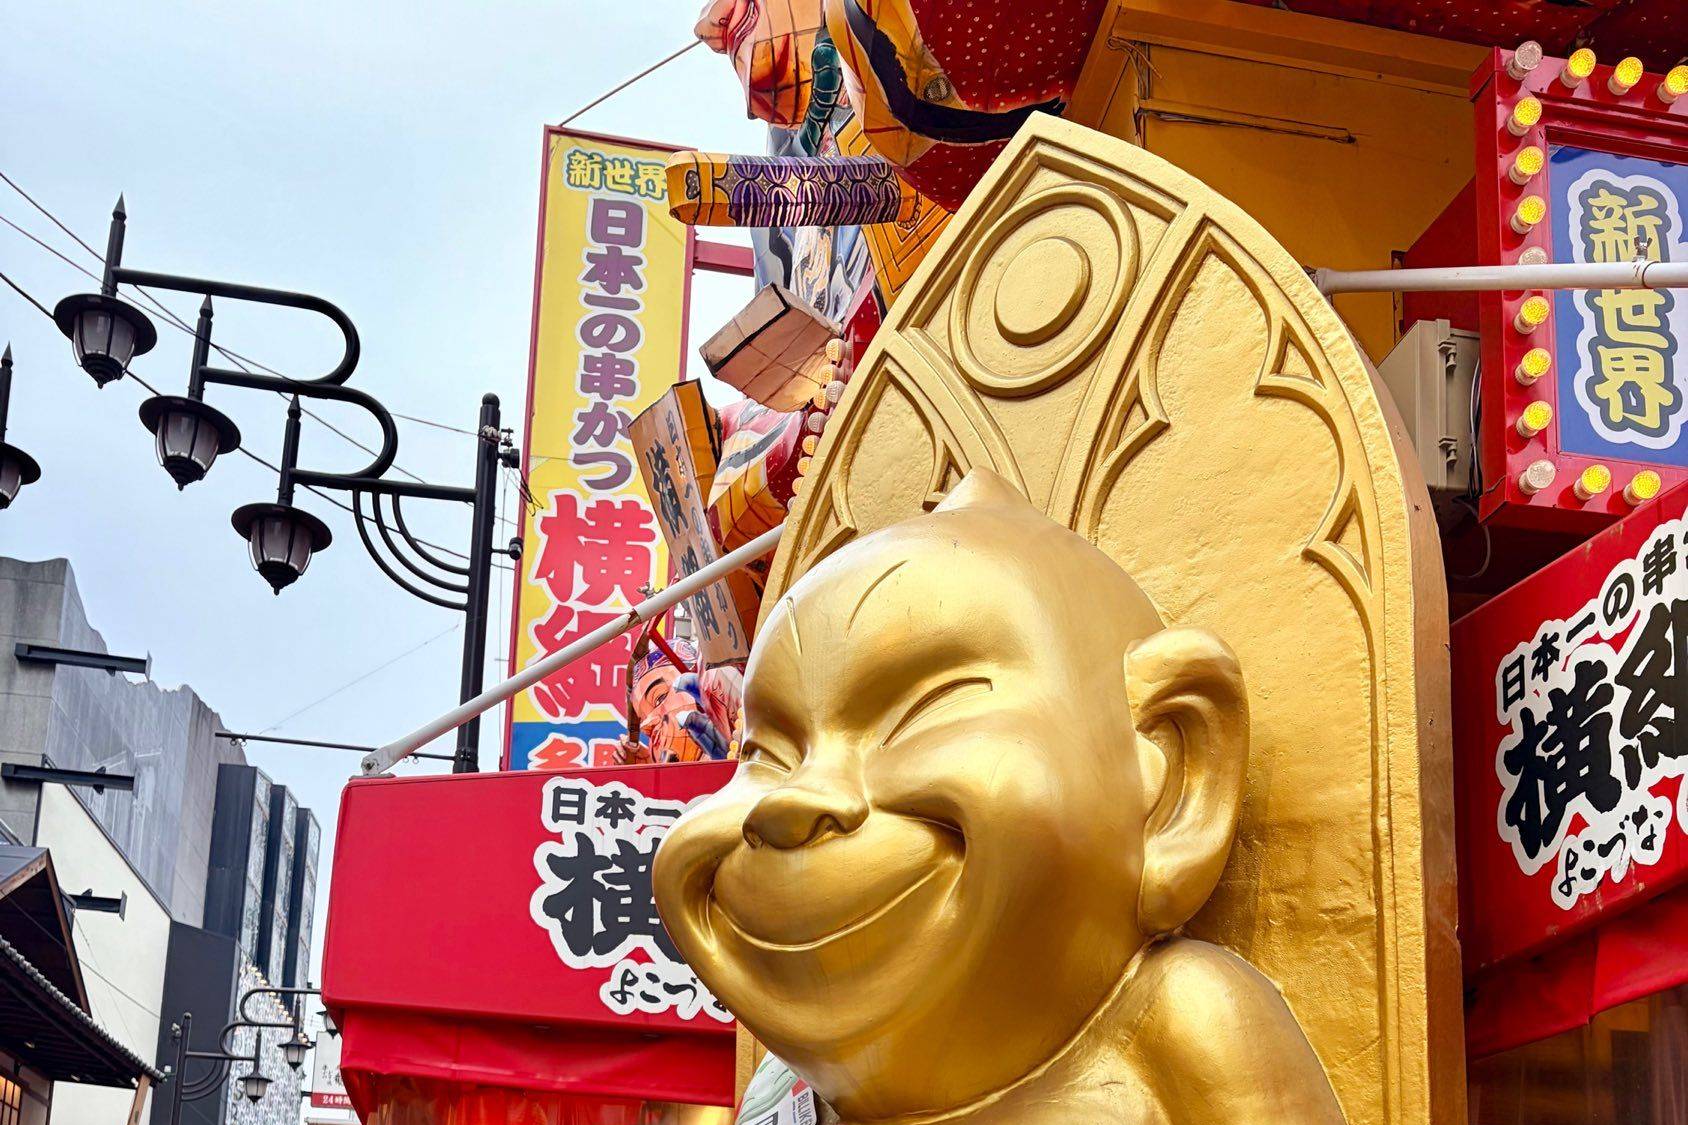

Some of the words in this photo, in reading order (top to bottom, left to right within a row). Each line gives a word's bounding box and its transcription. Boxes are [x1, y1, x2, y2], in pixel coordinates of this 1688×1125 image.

[567, 150, 667, 199] 新世界
[573, 200, 643, 490] 日本一の串かつ
[1583, 184, 1678, 433] 新世界
[1502, 531, 1688, 713] 日本一の串
[610, 968, 727, 1012] よこづ
